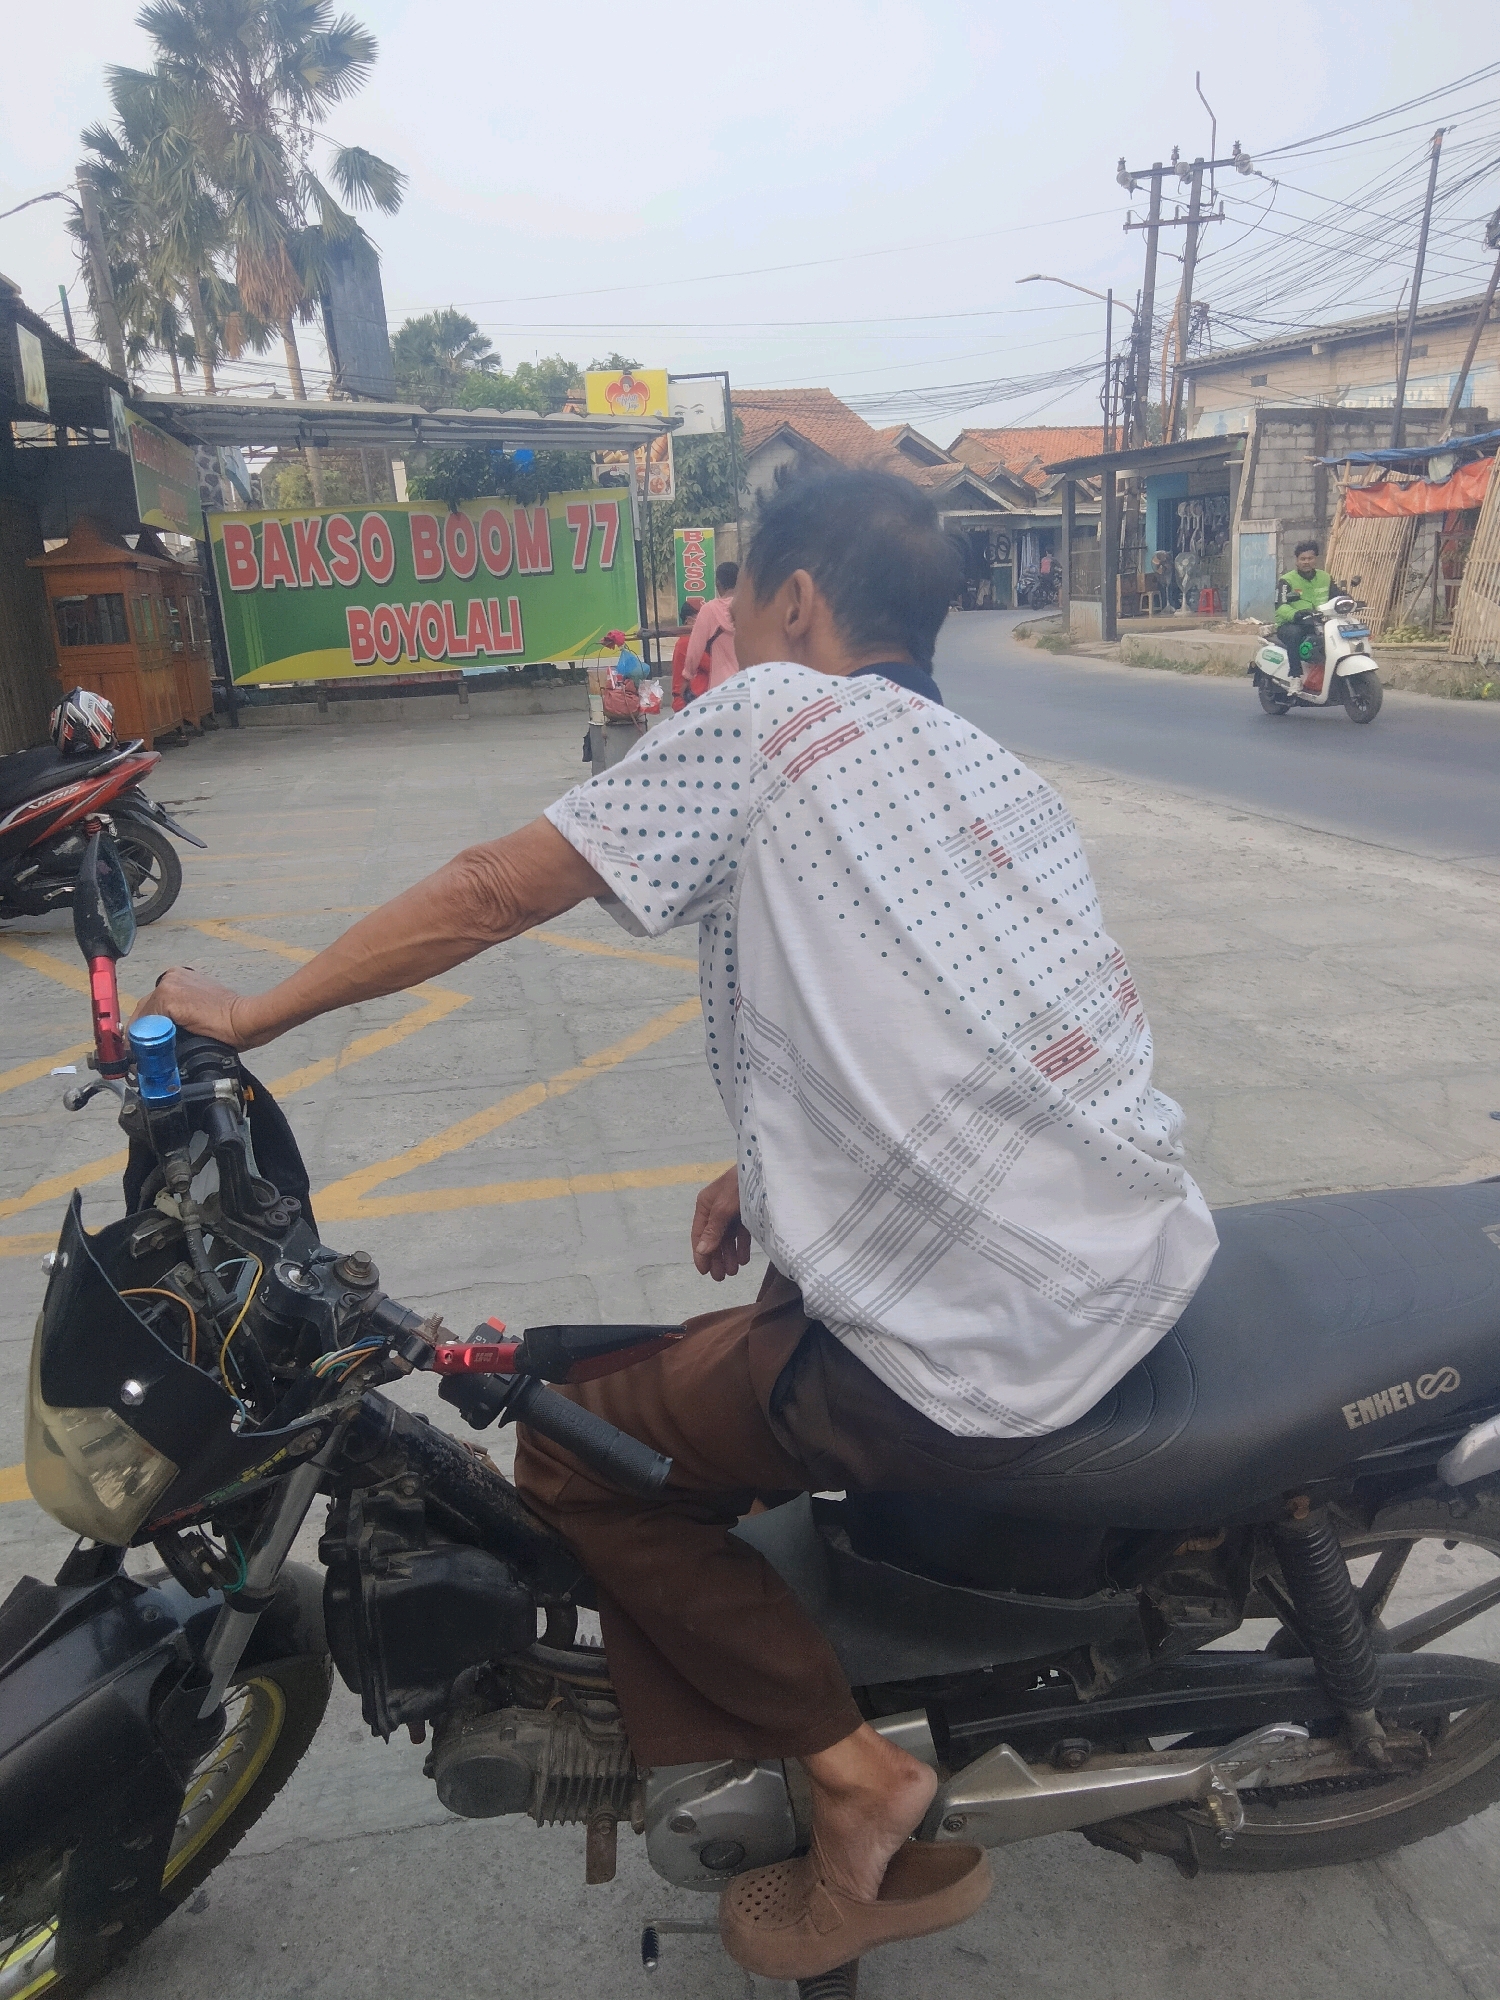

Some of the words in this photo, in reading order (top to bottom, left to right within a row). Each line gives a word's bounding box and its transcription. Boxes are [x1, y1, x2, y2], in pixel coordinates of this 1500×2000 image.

[222, 513, 395, 590] BAKSO
[409, 506, 553, 580] BOOM
[566, 501, 621, 570] 77
[682, 530, 706, 592] BAKSO
[345, 596, 525, 664] BOYOLALI
[1342, 1381, 1416, 1430] ENKEI
